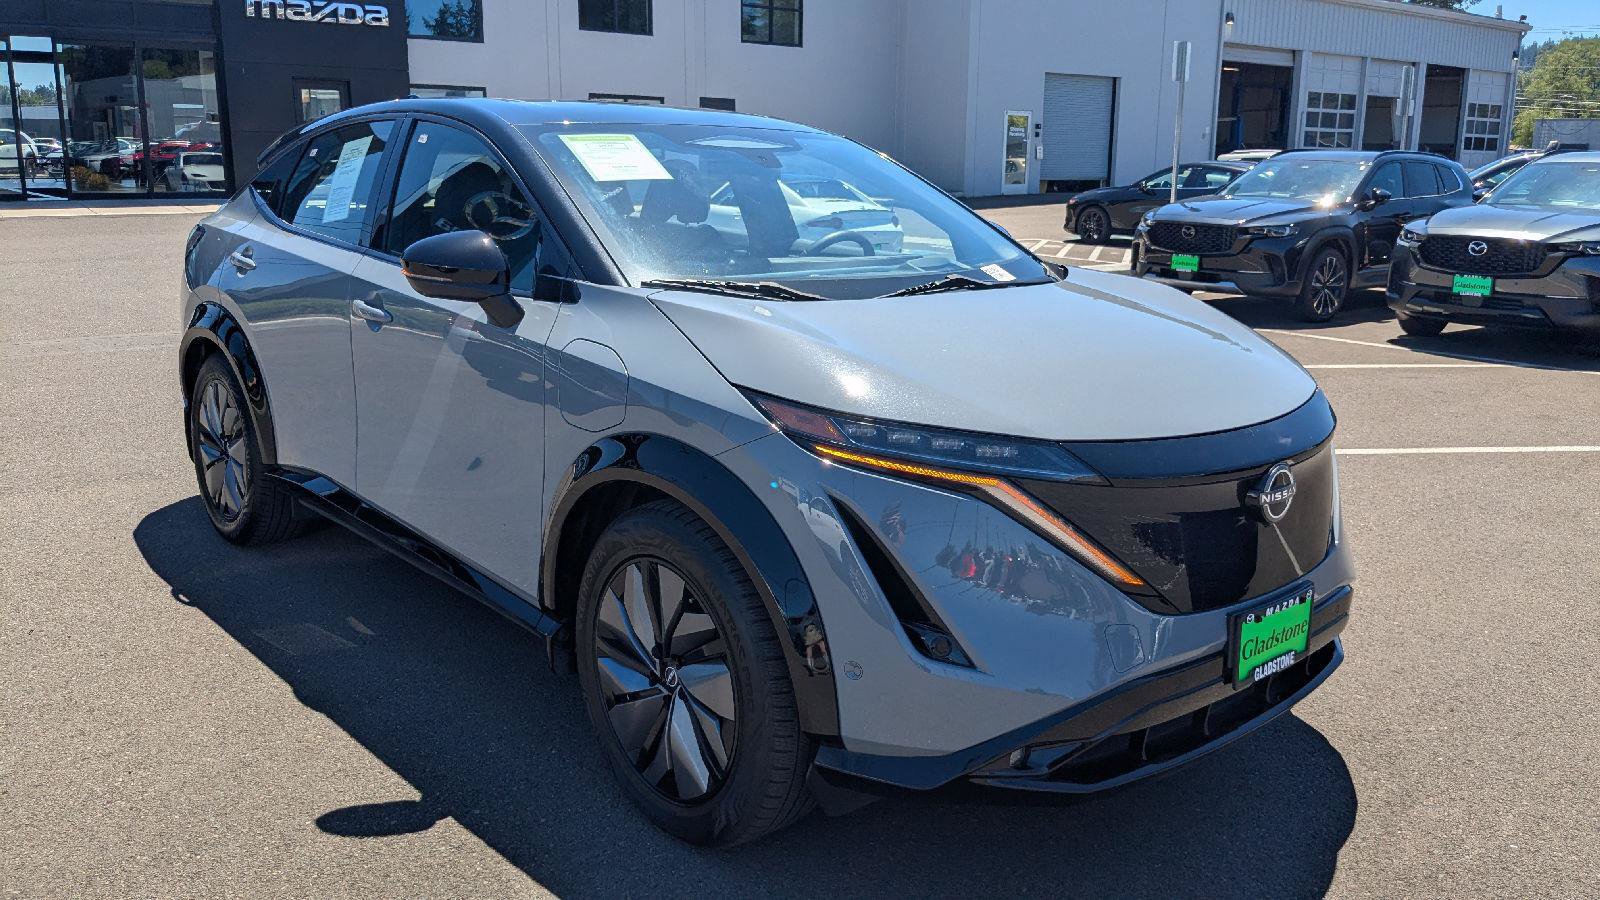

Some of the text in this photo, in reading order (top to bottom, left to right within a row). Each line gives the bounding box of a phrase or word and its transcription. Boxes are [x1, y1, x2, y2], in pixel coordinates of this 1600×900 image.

[1265, 596, 1300, 617] MAZDA
[1241, 619, 1308, 661] Gladstone
[1254, 651, 1296, 682] GLADSTONE
